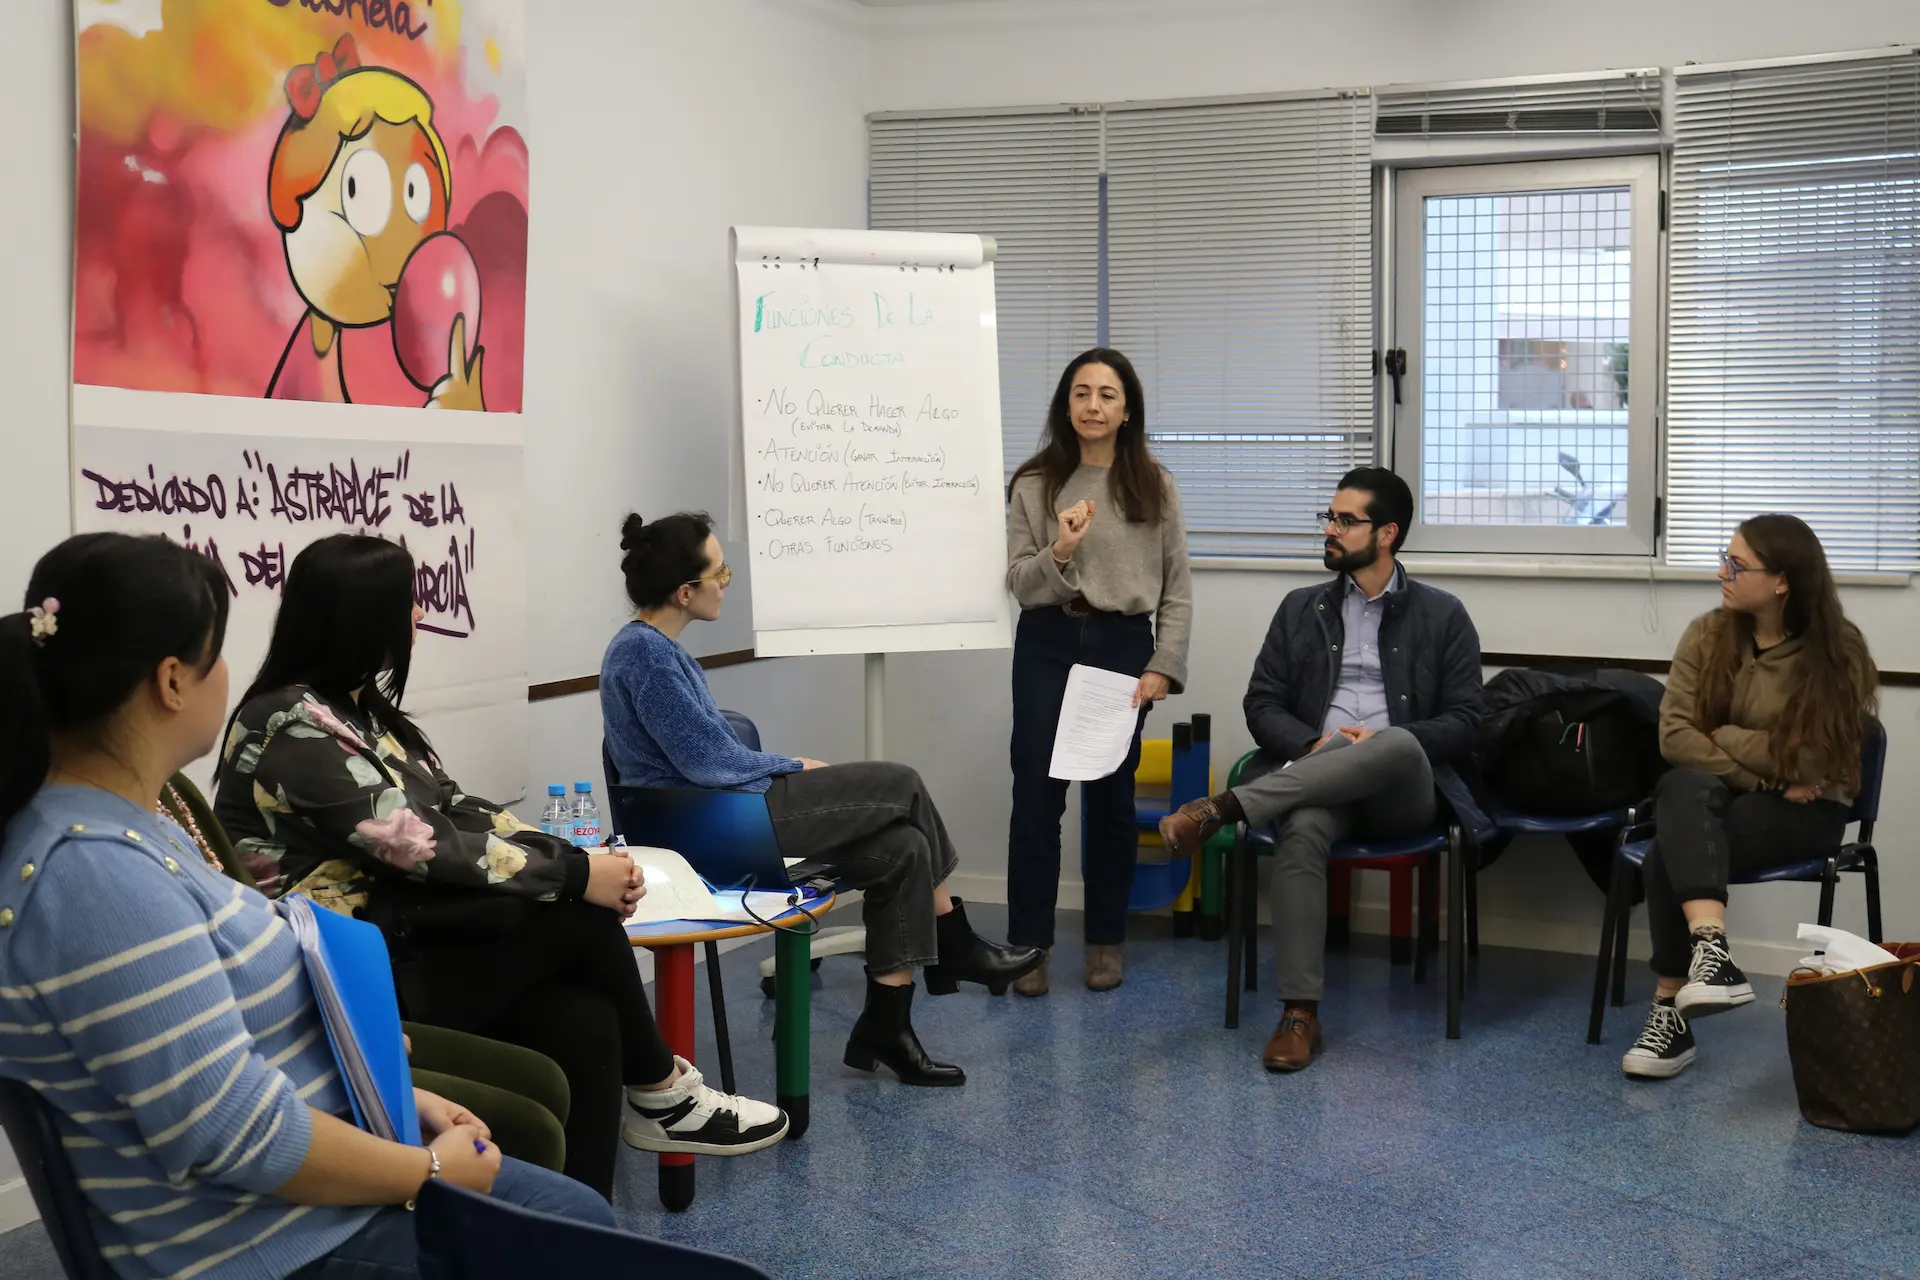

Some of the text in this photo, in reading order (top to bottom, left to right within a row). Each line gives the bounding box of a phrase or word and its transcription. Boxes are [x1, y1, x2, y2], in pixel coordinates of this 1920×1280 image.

[807, 389, 860, 418] QUERER
[869, 393, 907, 420] HACER
[916, 393, 959, 422] ALGO
[790, 472, 837, 493] QUERER
[82, 464, 226, 519] DEDICADO
[403, 491, 438, 527] DE
[440, 482, 465, 525] LA
[764, 508, 816, 527] QUERER
[821, 508, 852, 526] ALGO
[768, 539, 814, 559] OTRAS
